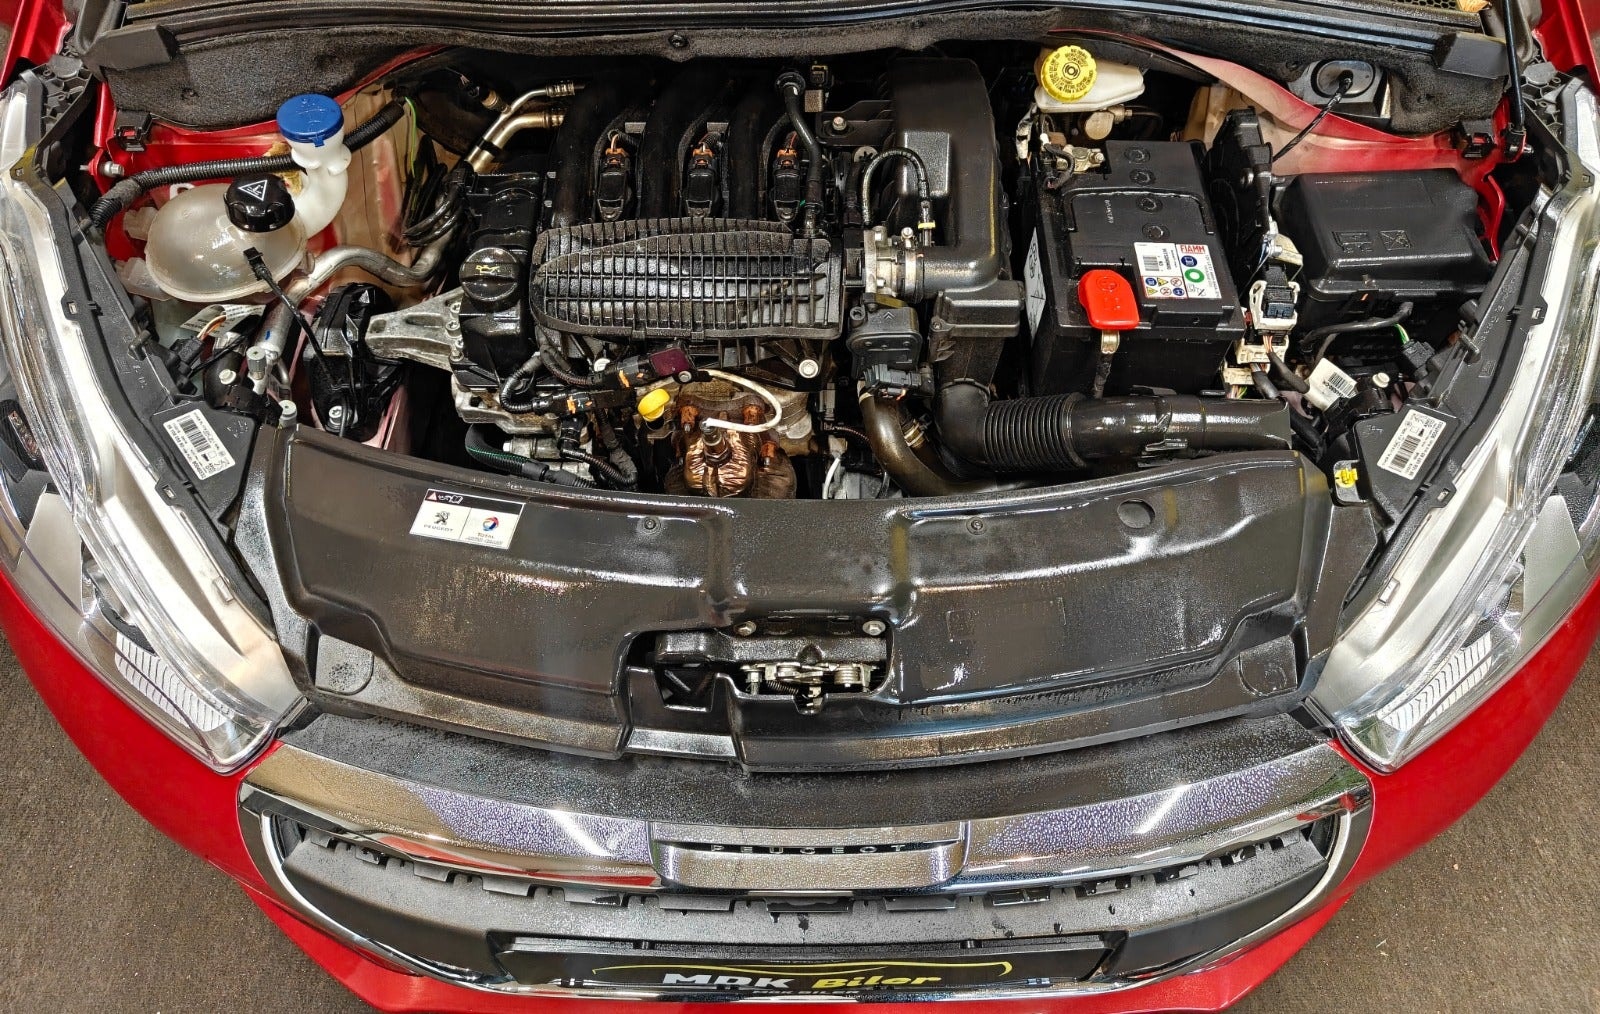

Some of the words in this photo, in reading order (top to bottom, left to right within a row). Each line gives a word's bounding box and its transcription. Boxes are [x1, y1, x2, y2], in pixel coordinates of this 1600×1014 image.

[1180, 244, 1205, 254] FIAMM
[423, 524, 454, 532] PEUGEOT
[711, 844, 906, 855] PEUGEOT
[662, 973, 795, 988] MDK
[811, 975, 942, 989] Biler
